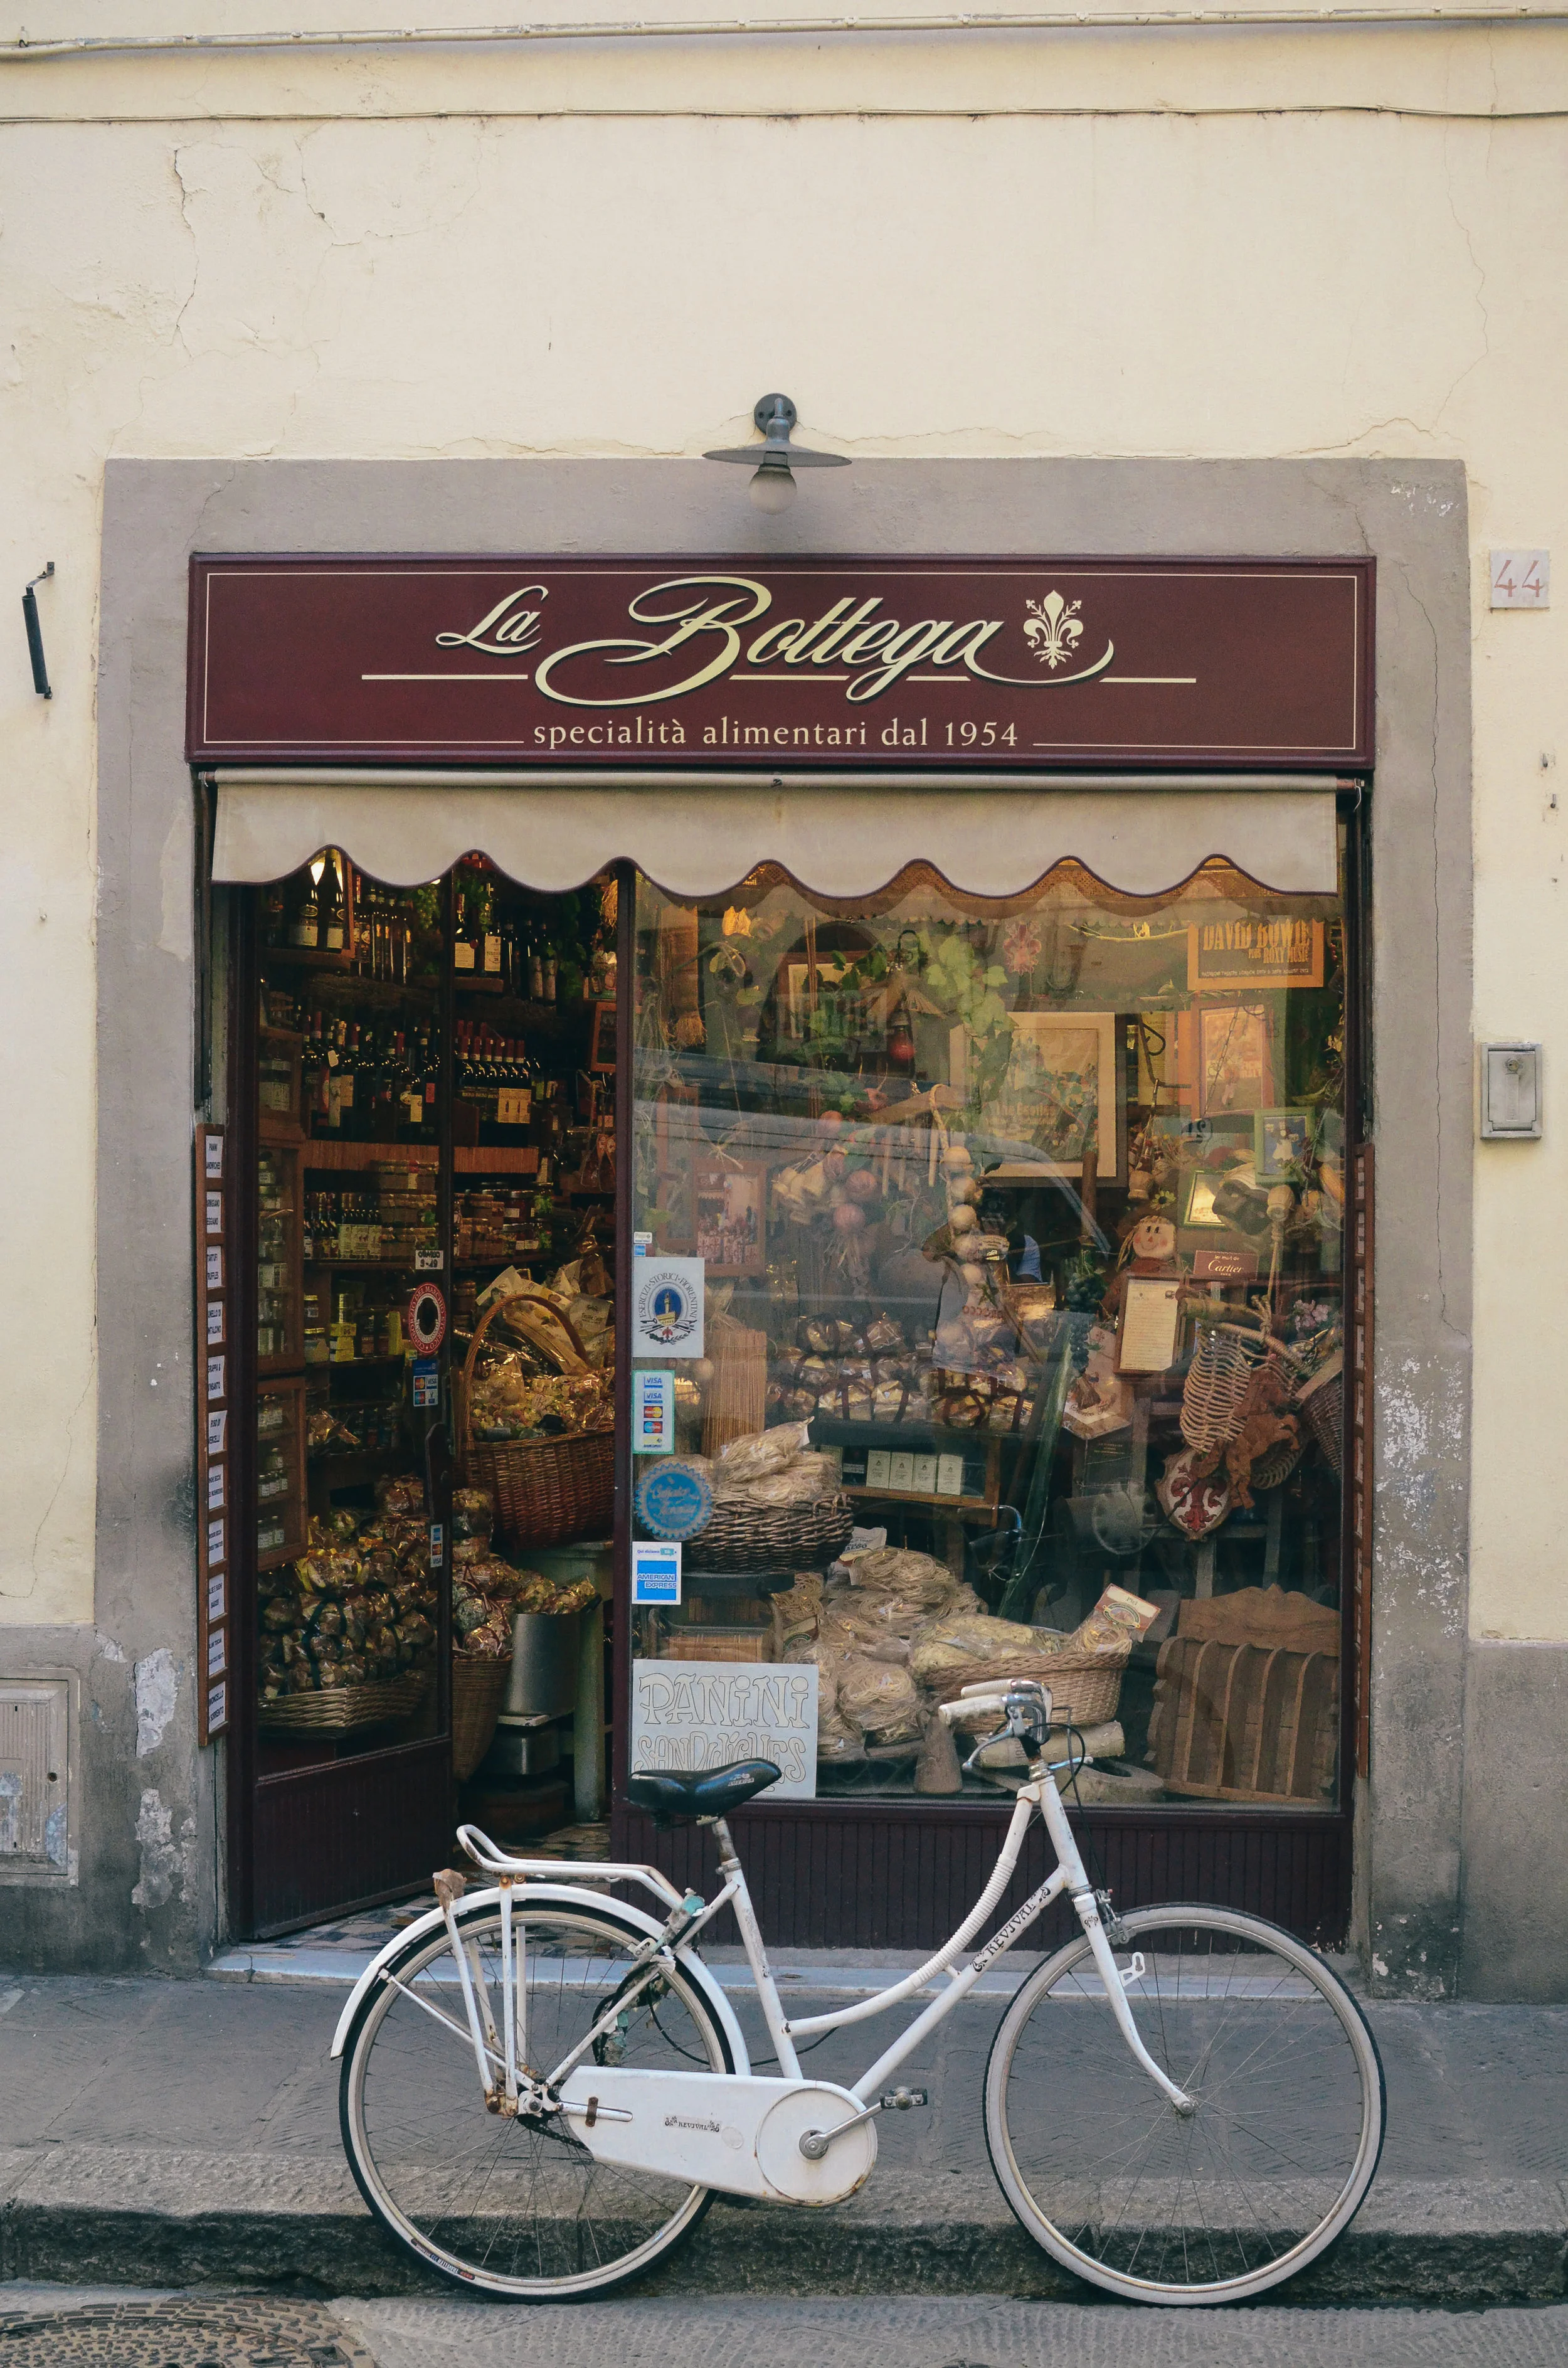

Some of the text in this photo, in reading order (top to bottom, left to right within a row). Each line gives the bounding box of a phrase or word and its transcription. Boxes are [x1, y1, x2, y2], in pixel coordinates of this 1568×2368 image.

[1494, 560, 1545, 597] 44
[435, 575, 1115, 706] La Bottega
[534, 716, 1018, 750] specialità alimentari dal 1954
[1204, 918, 1310, 951] DAVID BOWIE
[1263, 947, 1285, 964] ROXY
[1286, 947, 1309, 963] MUSIC
[1208, 1259, 1242, 1273] Cartier
[415, 1288, 425, 1301] DEL
[638, 1283, 650, 1319] ESERCIZI
[649, 1272, 679, 1287] STORICI
[679, 1277, 698, 1319] FIORENTINI
[985, 1903, 1037, 1956] REVIVAL
[678, 2121, 709, 2130] REVIVAL
